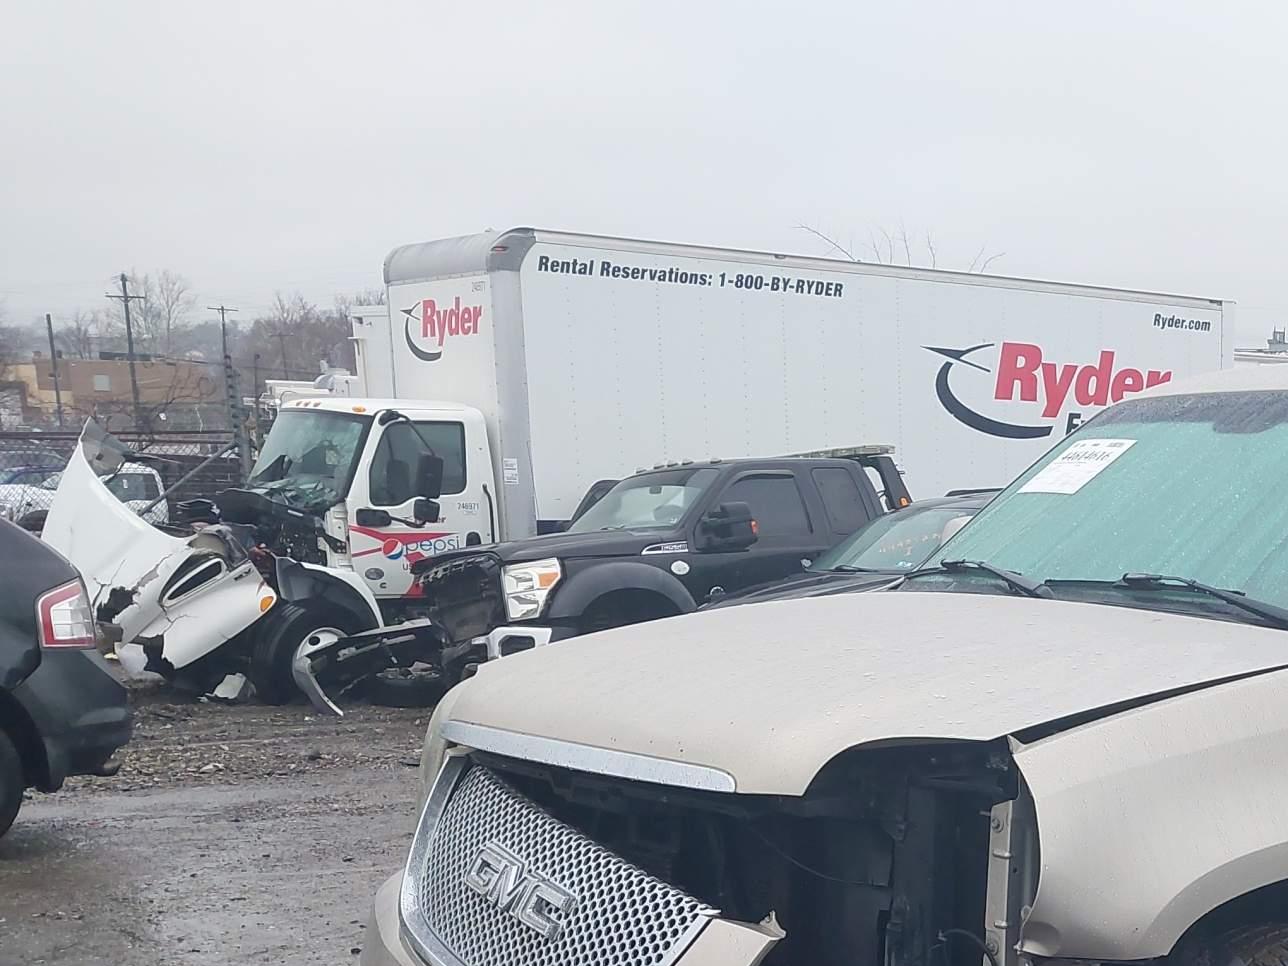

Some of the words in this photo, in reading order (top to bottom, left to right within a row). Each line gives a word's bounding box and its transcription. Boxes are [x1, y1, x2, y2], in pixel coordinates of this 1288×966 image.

[538, 255, 594, 276] Rental
[600, 261, 712, 286] Reservations:
[719, 272, 844, 297] 1-800-BY-RYDER
[422, 296, 482, 346] Ryder
[1153, 313, 1211, 331] Ryder.com
[994, 342, 1172, 418] Ryder
[406, 536, 459, 554] pepsi
[466, 841, 578, 942] GMC
